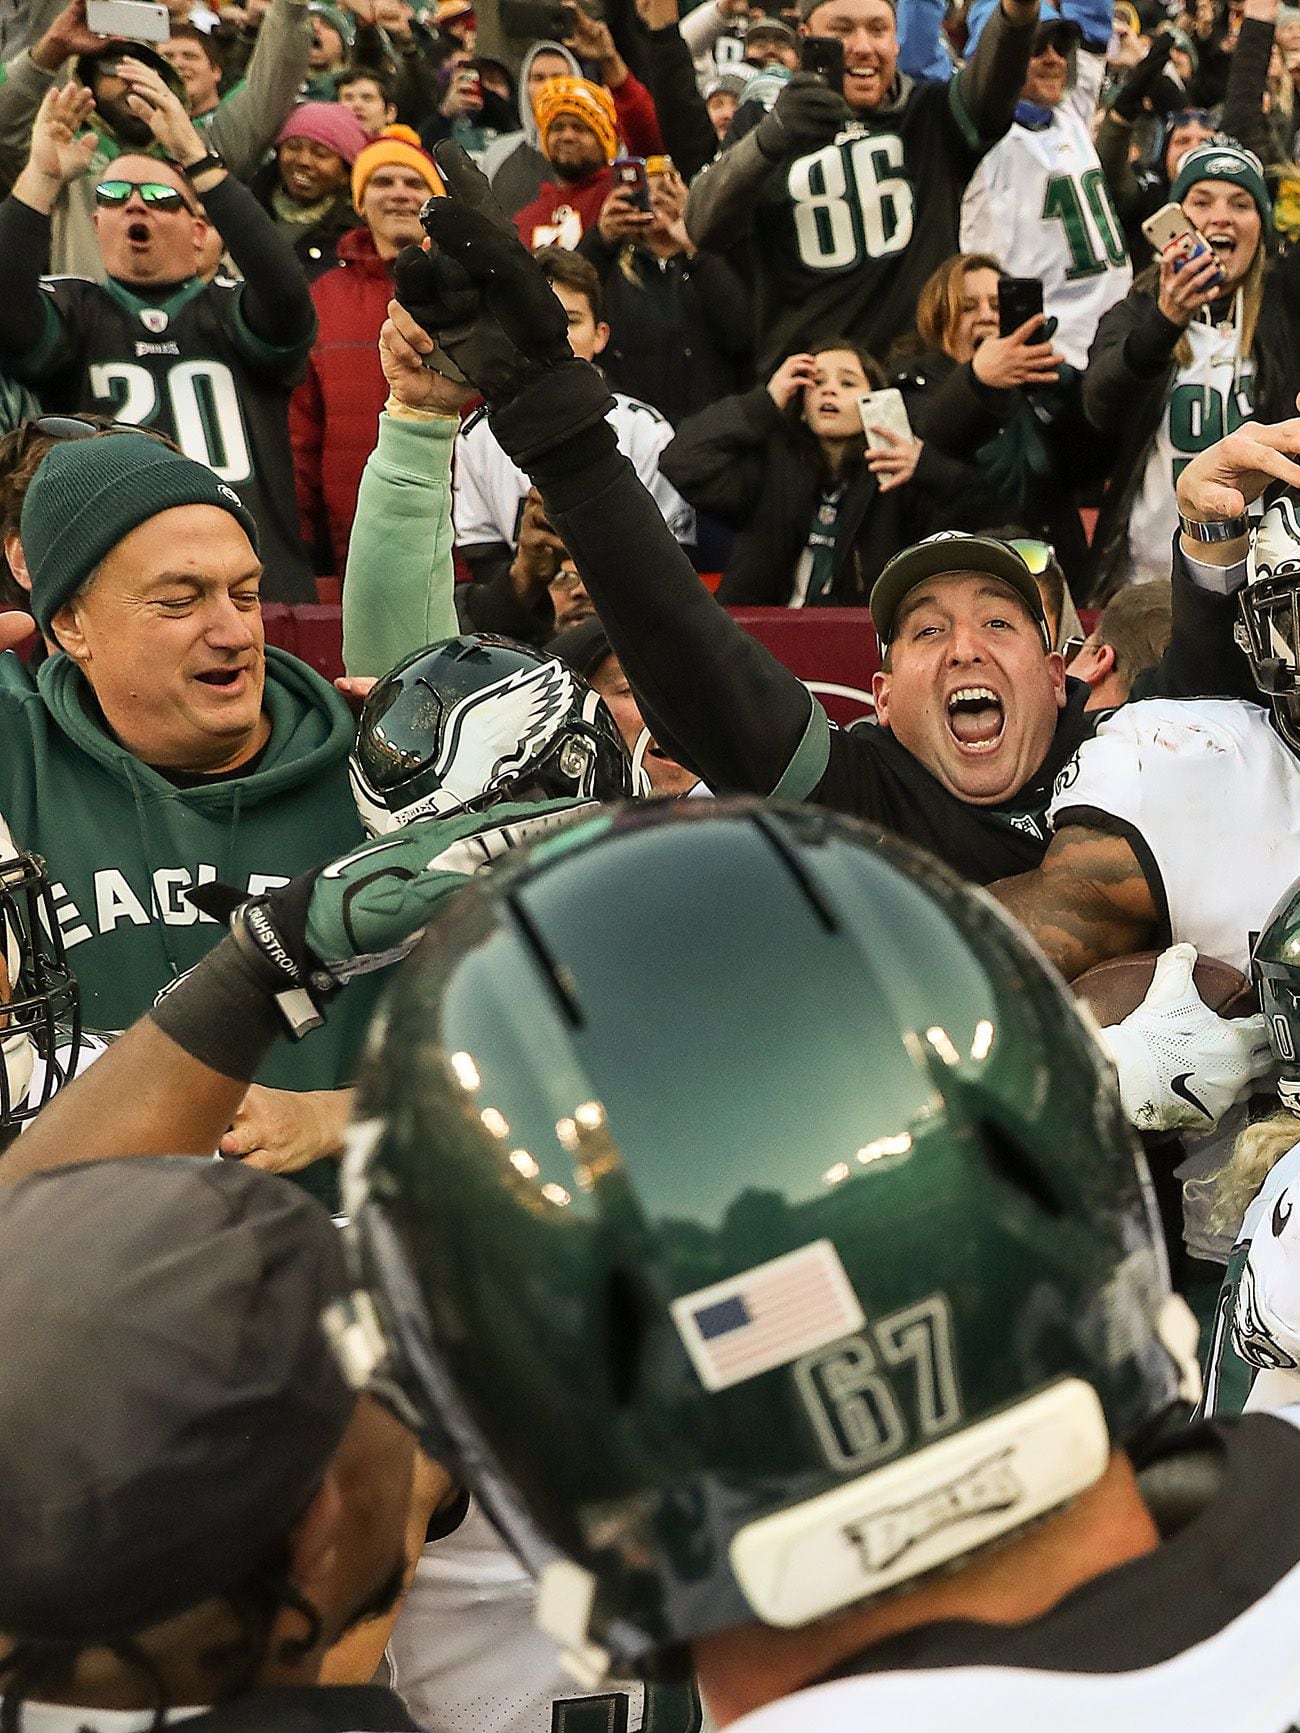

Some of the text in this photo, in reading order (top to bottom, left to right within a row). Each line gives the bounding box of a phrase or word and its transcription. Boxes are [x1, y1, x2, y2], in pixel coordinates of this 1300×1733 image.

[787, 134, 915, 269] 86
[1042, 168, 1130, 281] 10
[88, 359, 253, 483] 20
[792, 1292, 961, 1472] 67
